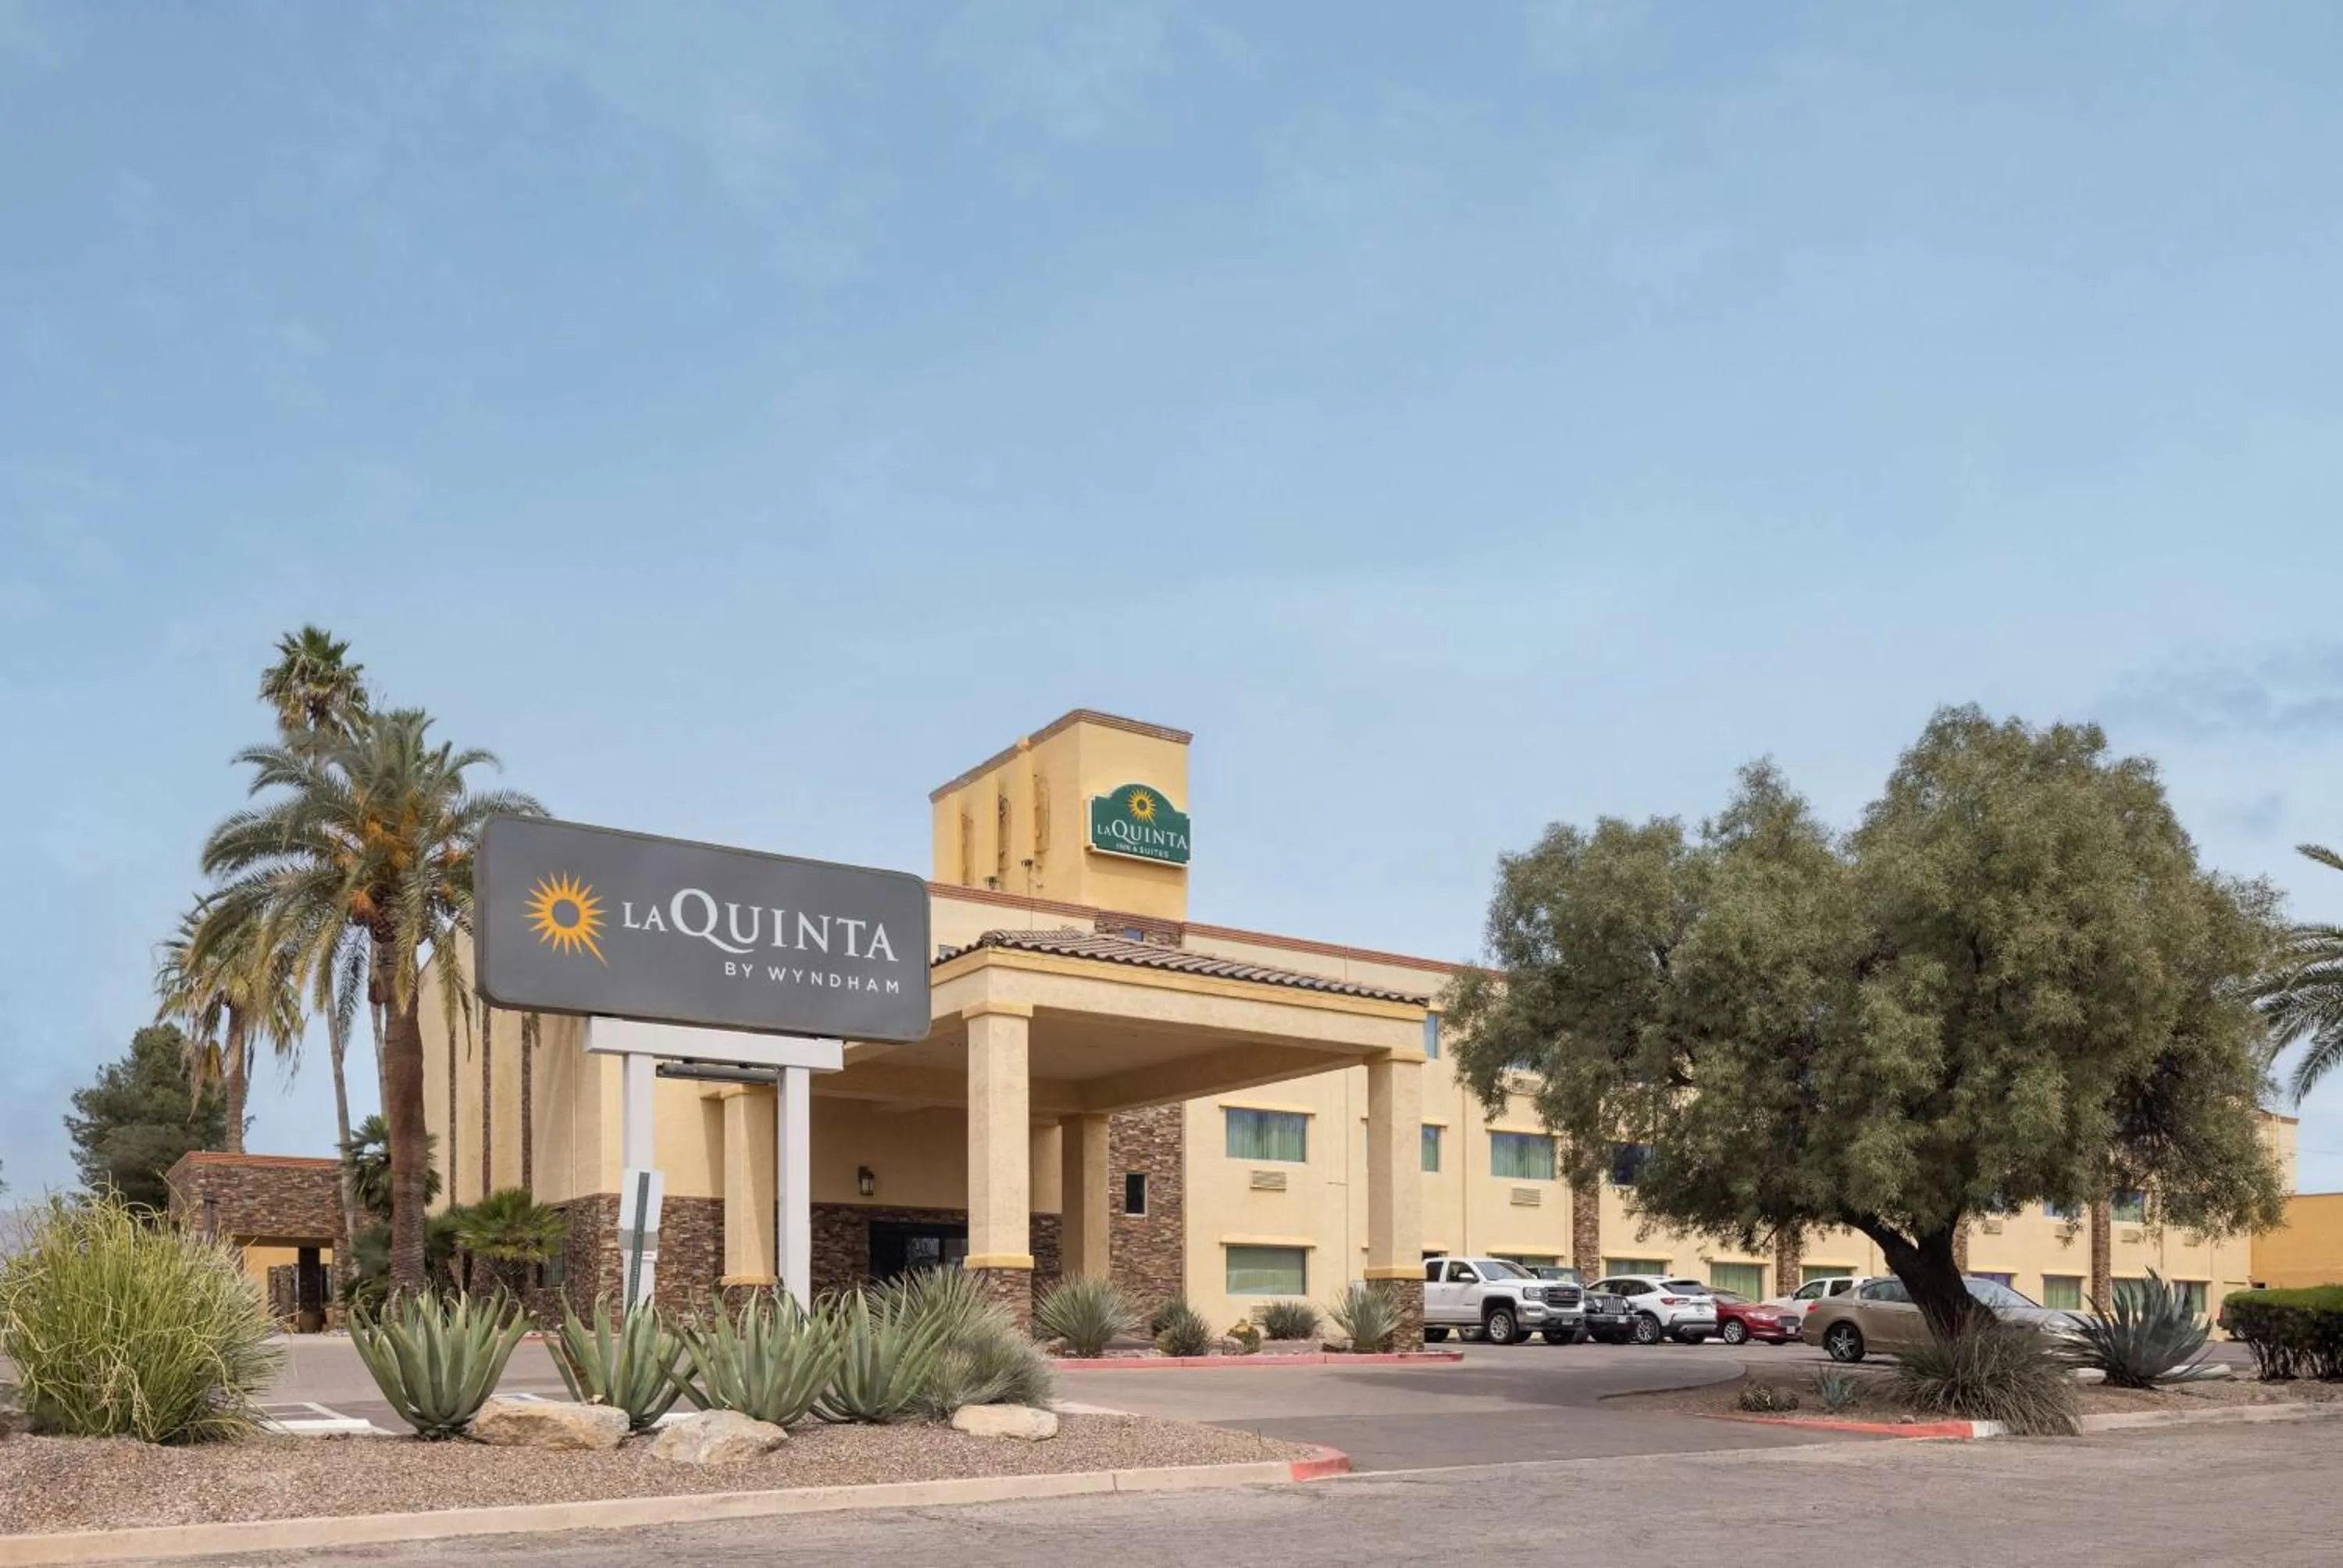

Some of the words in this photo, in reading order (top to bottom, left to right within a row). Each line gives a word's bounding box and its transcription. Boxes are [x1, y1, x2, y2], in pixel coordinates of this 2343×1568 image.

[1097, 824, 1111, 836] LA
[1111, 819, 1188, 850] QUINTA
[622, 901, 669, 932] LA
[670, 888, 900, 962] QUINTA
[725, 961, 753, 978] BY
[768, 965, 900, 994] WYNDHAM
